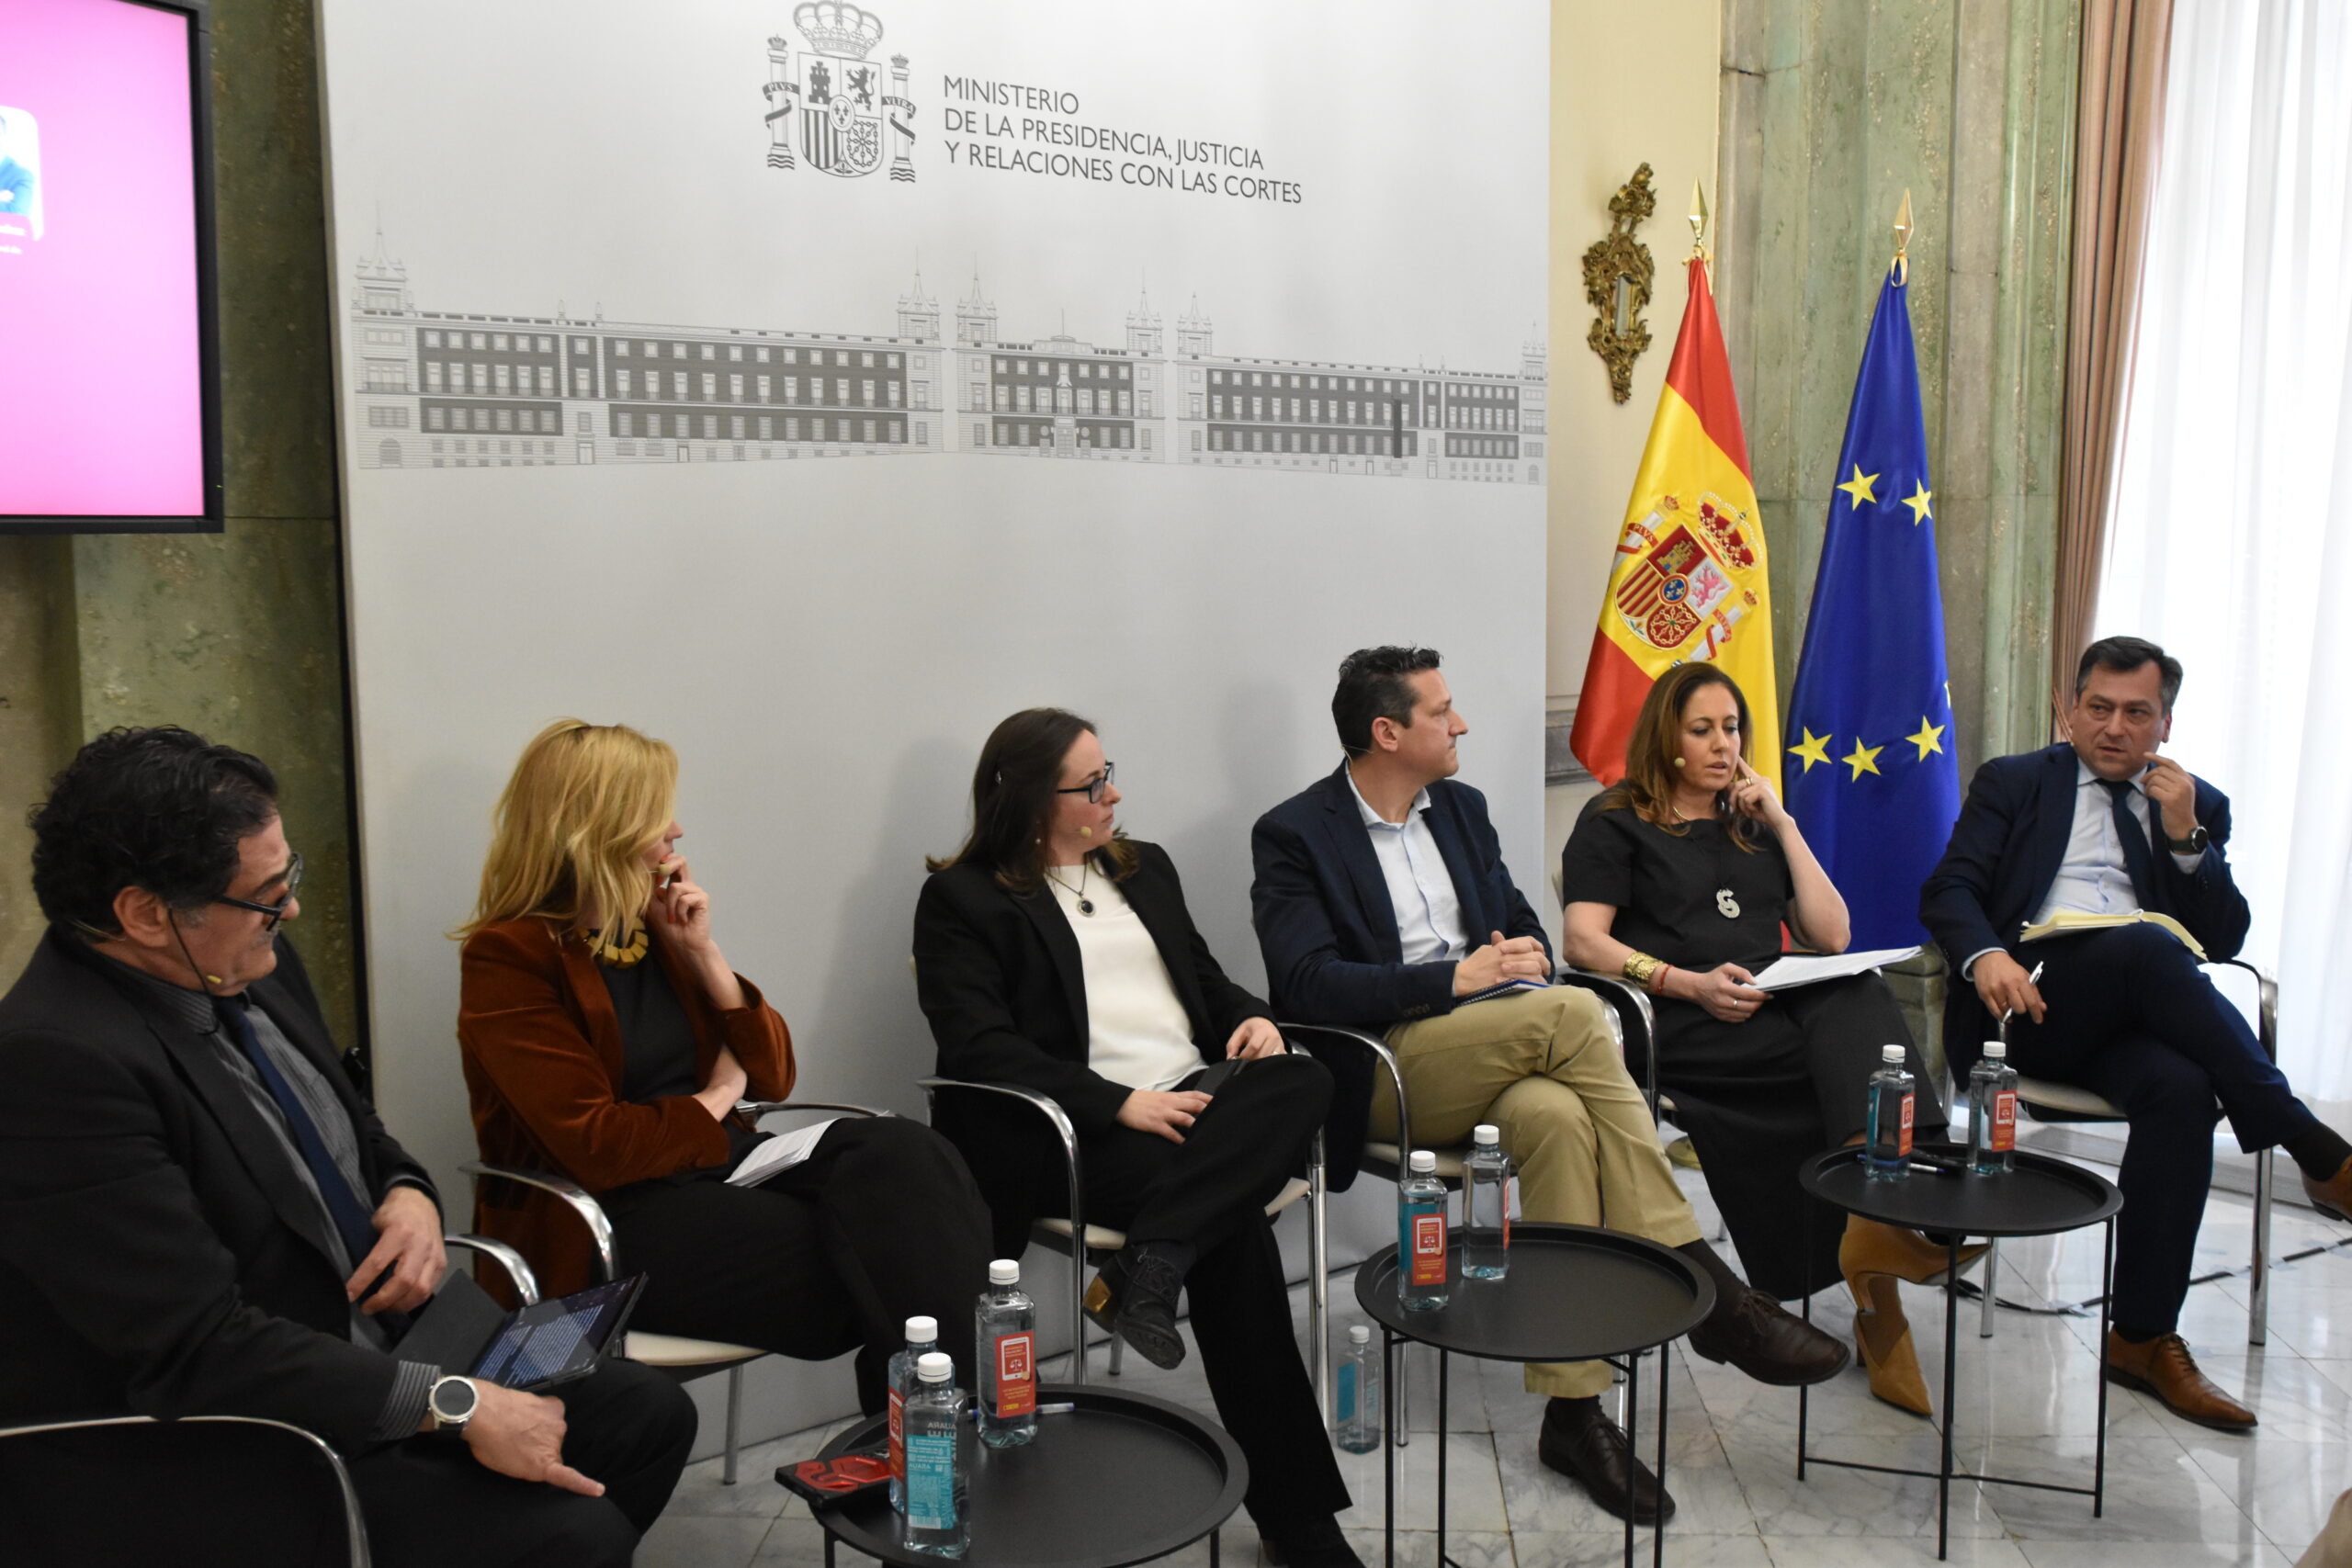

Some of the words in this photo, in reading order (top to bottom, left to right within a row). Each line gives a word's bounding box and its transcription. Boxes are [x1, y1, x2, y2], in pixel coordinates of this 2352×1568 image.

[768, 83, 794, 93] PLVS
[944, 74, 1080, 115] MINISTERIO
[944, 107, 978, 134] DE
[985, 113, 1015, 139] LA
[1023, 118, 1172, 161] PRESIDENCIA,
[1175, 139, 1264, 171] JUSTICIA
[944, 140, 960, 164] Y
[969, 142, 1114, 182] RELACIONES
[1120, 162, 1173, 189] CON
[1182, 169, 1217, 195] LAS
[1224, 175, 1302, 204] CORTES
